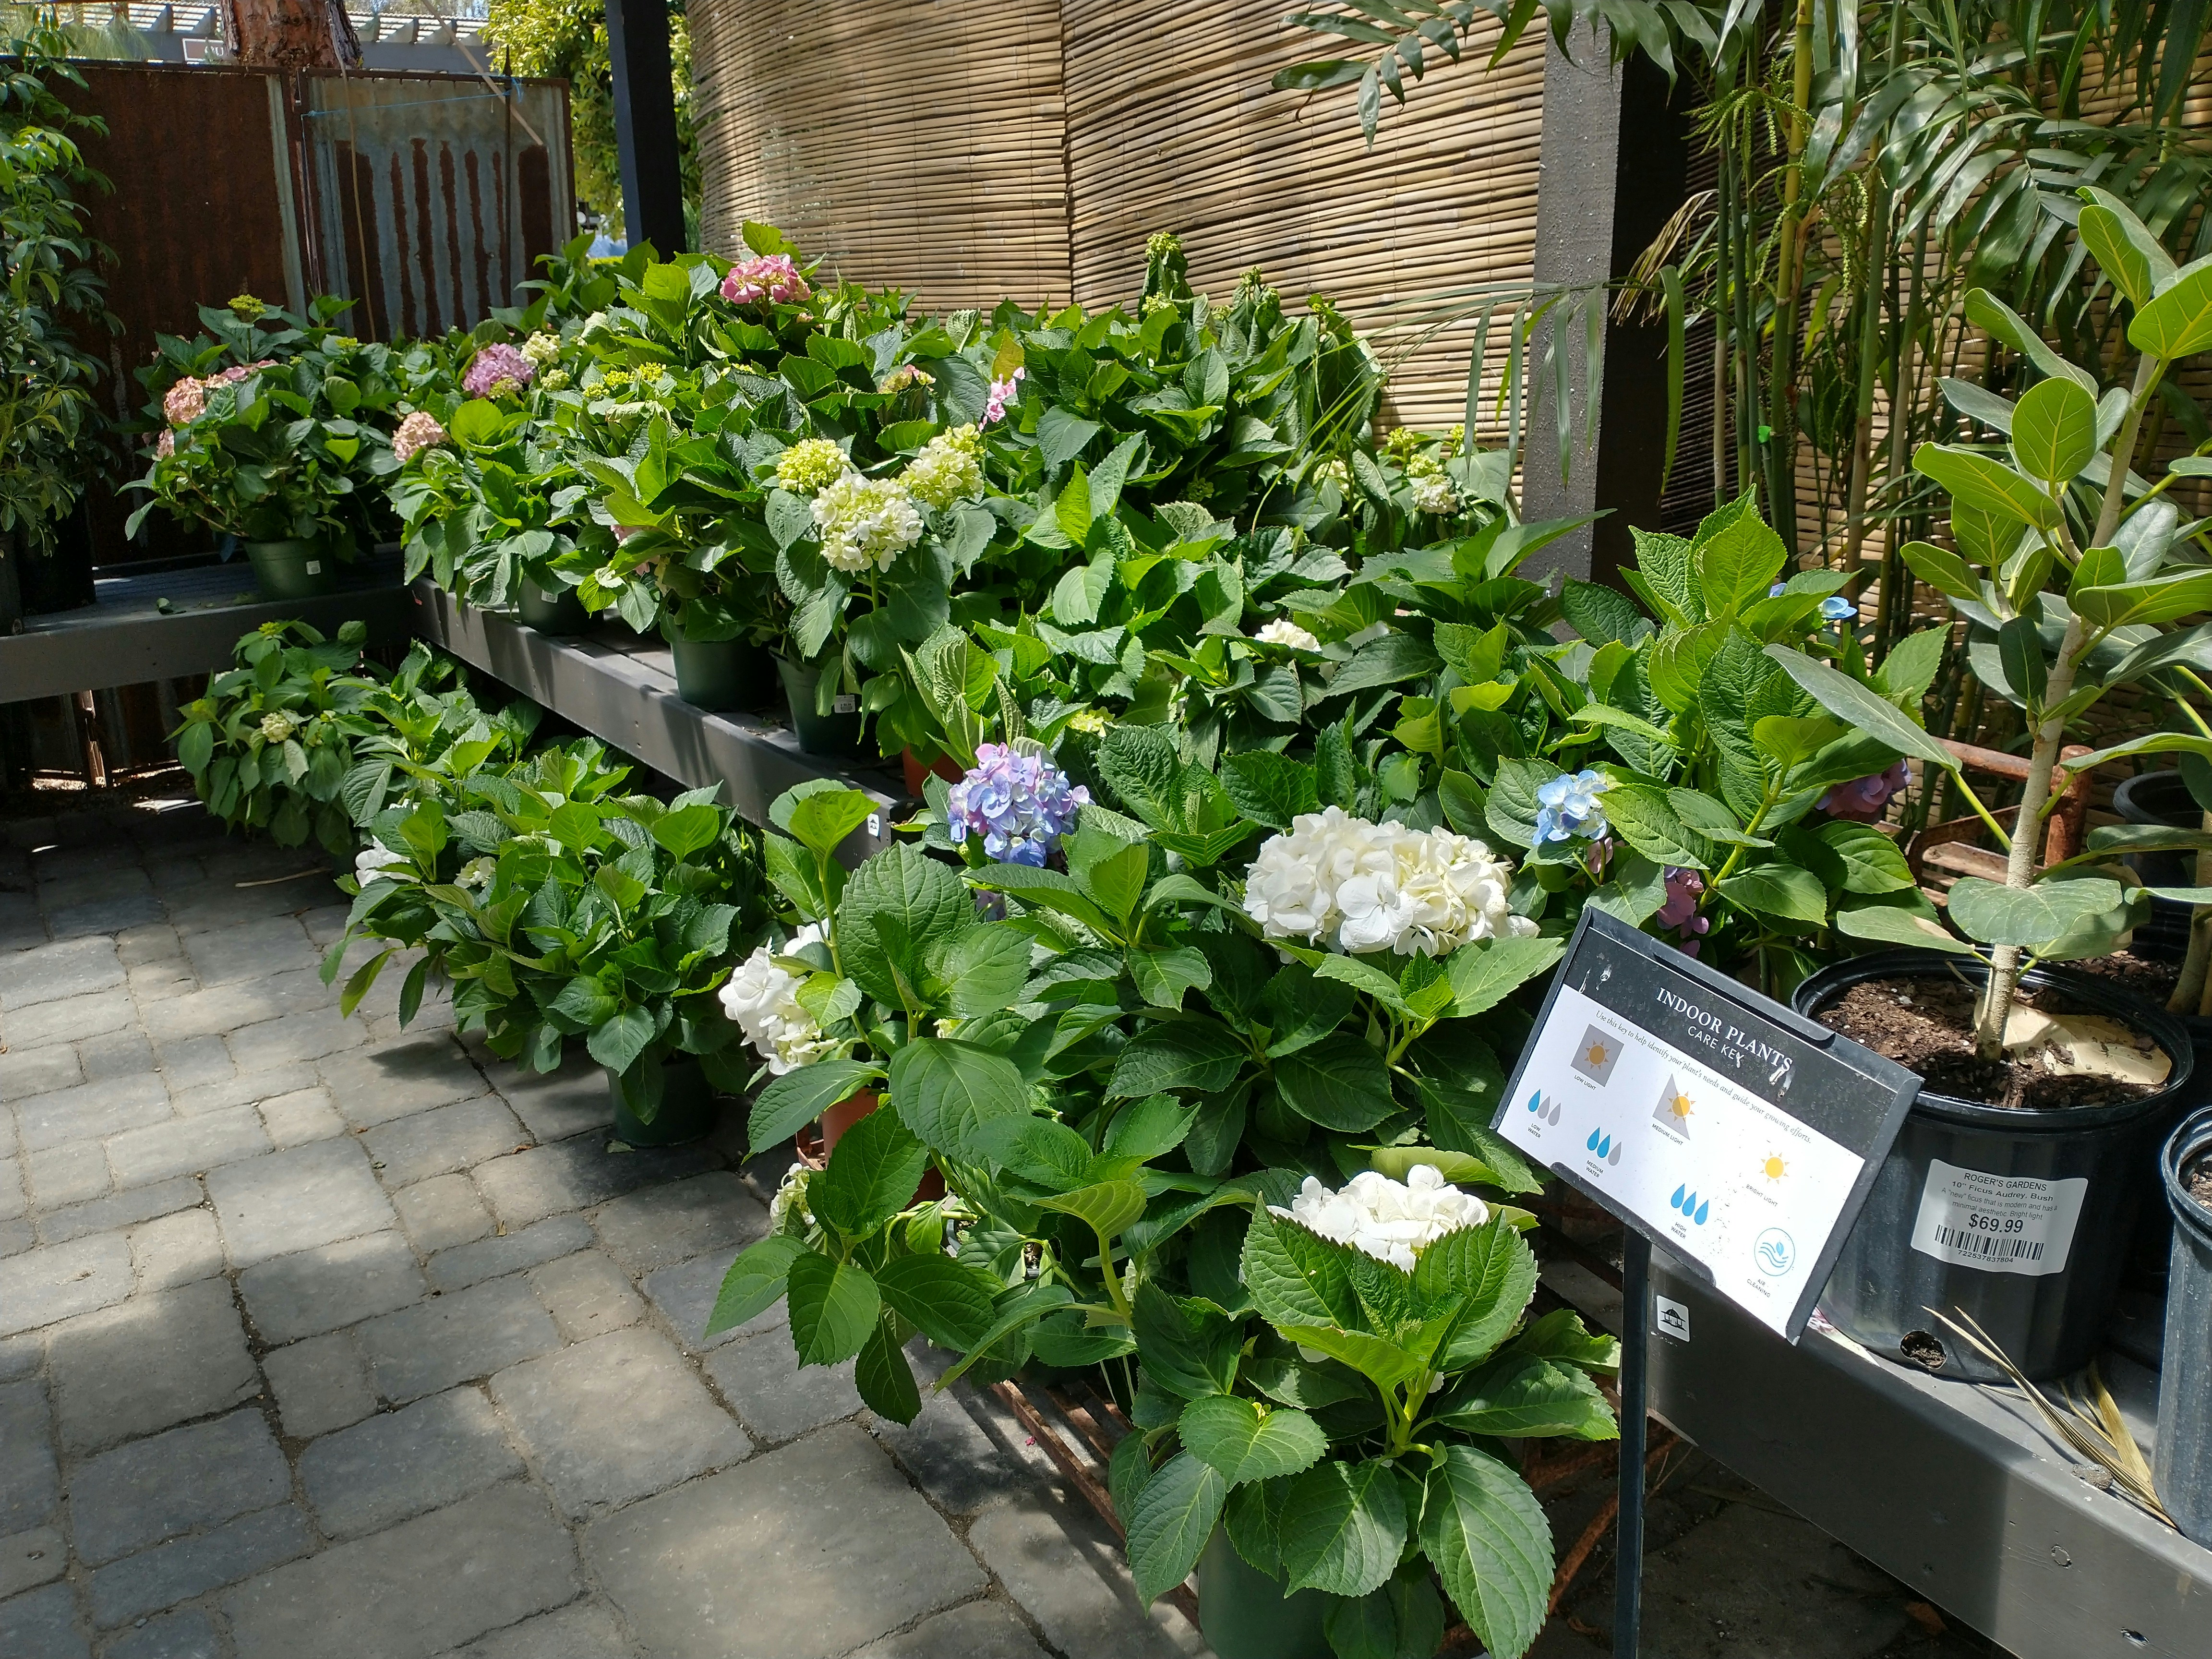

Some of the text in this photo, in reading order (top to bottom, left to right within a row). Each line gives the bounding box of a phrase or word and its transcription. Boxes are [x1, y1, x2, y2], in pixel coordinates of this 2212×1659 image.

[1656, 987, 1793, 1071] INDOOR PLANTS
[1688, 1026, 1745, 1064] CARE KEY
[1574, 1074, 1596, 1091] LOW LIGHT
[1596, 1010, 1606, 1022] Use
[1607, 1016, 1618, 1028] this
[1617, 1023, 1628, 1035] key
[1634, 1032, 1647, 1045] help
[1647, 1041, 1669, 1058] identify
[1668, 1056, 1683, 1066] your
[1682, 1062, 1702, 1078] plant's
[1703, 1075, 1719, 1088] needs
[1719, 1085, 1733, 1096] and
[1731, 1094, 1750, 1106] guide
[1749, 1104, 1765, 1114] your
[1764, 1112, 1790, 1131] growing
[1790, 1127, 1811, 1143] efforts.
[1527, 1127, 1541, 1139] WATER
[1531, 1123, 1541, 1131] LOW
[1651, 1123, 1683, 1146] MEDIUM LIGHT
[1586, 1166, 1600, 1178] WATER
[1587, 1160, 1604, 1174] MEDIUM
[1964, 1173, 2047, 1191] ROGER'S GARDENS
[1746, 1184, 1778, 1207] BRIGHT LIGHT
[1948, 1190, 1967, 1199] "new"
[1968, 1194, 1982, 1203] ficus
[1984, 1198, 1996, 1206] that
[1969, 1185, 1993, 1195] Ficus
[2030, 1193, 2054, 1202] Bush
[1952, 1201, 1977, 1211] minimal
[2009, 1210, 2028, 1218] Bright
[2029, 1212, 2043, 1220] light
[1675, 1222, 1687, 1233] HIGH
[1969, 1213, 2023, 1233] $69.99
[1671, 1226, 1686, 1239] WATER
[1958, 1250, 2013, 1263] 722537837804
[1747, 1279, 1771, 1298] CLEANING
[1757, 1278, 1766, 1287] AIR
